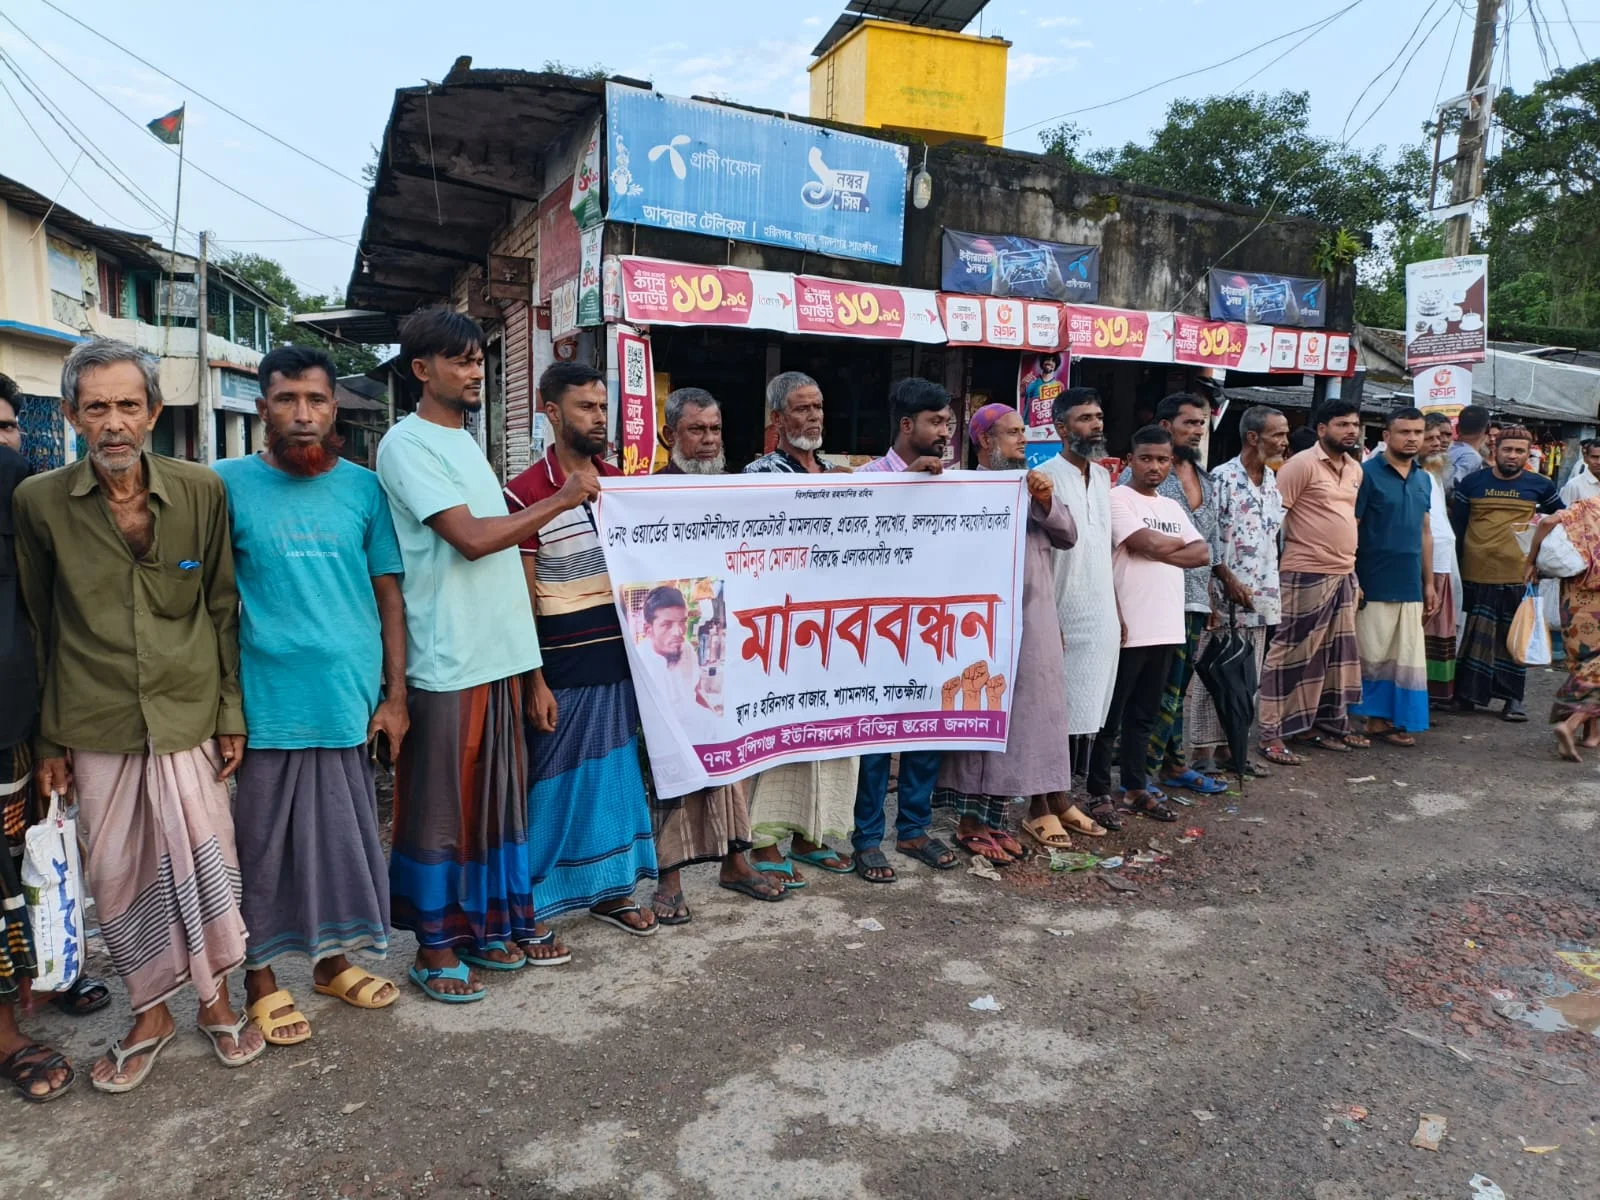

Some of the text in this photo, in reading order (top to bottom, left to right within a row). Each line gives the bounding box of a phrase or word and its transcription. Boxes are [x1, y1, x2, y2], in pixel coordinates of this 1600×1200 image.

[690, 149, 761, 182] গ্রামীণফোন
[836, 172, 864, 190] নম্বর
[841, 191, 862, 211] সিম
[642, 205, 746, 235] আব্দুল্লাহ টেলিকম
[633, 276, 666, 292] ক্যাশ
[628, 291, 667, 305] আউট
[804, 292, 832, 306] ক্যাশ
[799, 304, 834, 318] আউট
[1032, 398, 1055, 413] বিকা
[858, 488, 873, 499] রহিম
[1484, 488, 1521, 498] Musafir
[631, 516, 669, 544] ওয়ার্ডের
[672, 513, 740, 543] আওয়ামীলীগের
[741, 511, 787, 540] সেক্রেটারী
[789, 516, 834, 539] মামলাবাজ,
[837, 515, 870, 538] প্রতারক,
[725, 541, 914, 579] আমিনুর মোল্যার বিরুদ্ধে এলাকাবাসীর পক্ষে
[733, 593, 1006, 676] মানববন্ধন
[760, 691, 795, 717] হরিনগর
[798, 689, 829, 710] বাজার,
[833, 684, 878, 706] শ্যামনগর,
[703, 750, 733, 768] ৭নং
[780, 724, 852, 746] ইউনিয়নের
[857, 716, 899, 738] বিভিন্ন
[902, 717, 940, 734] স্তরের
